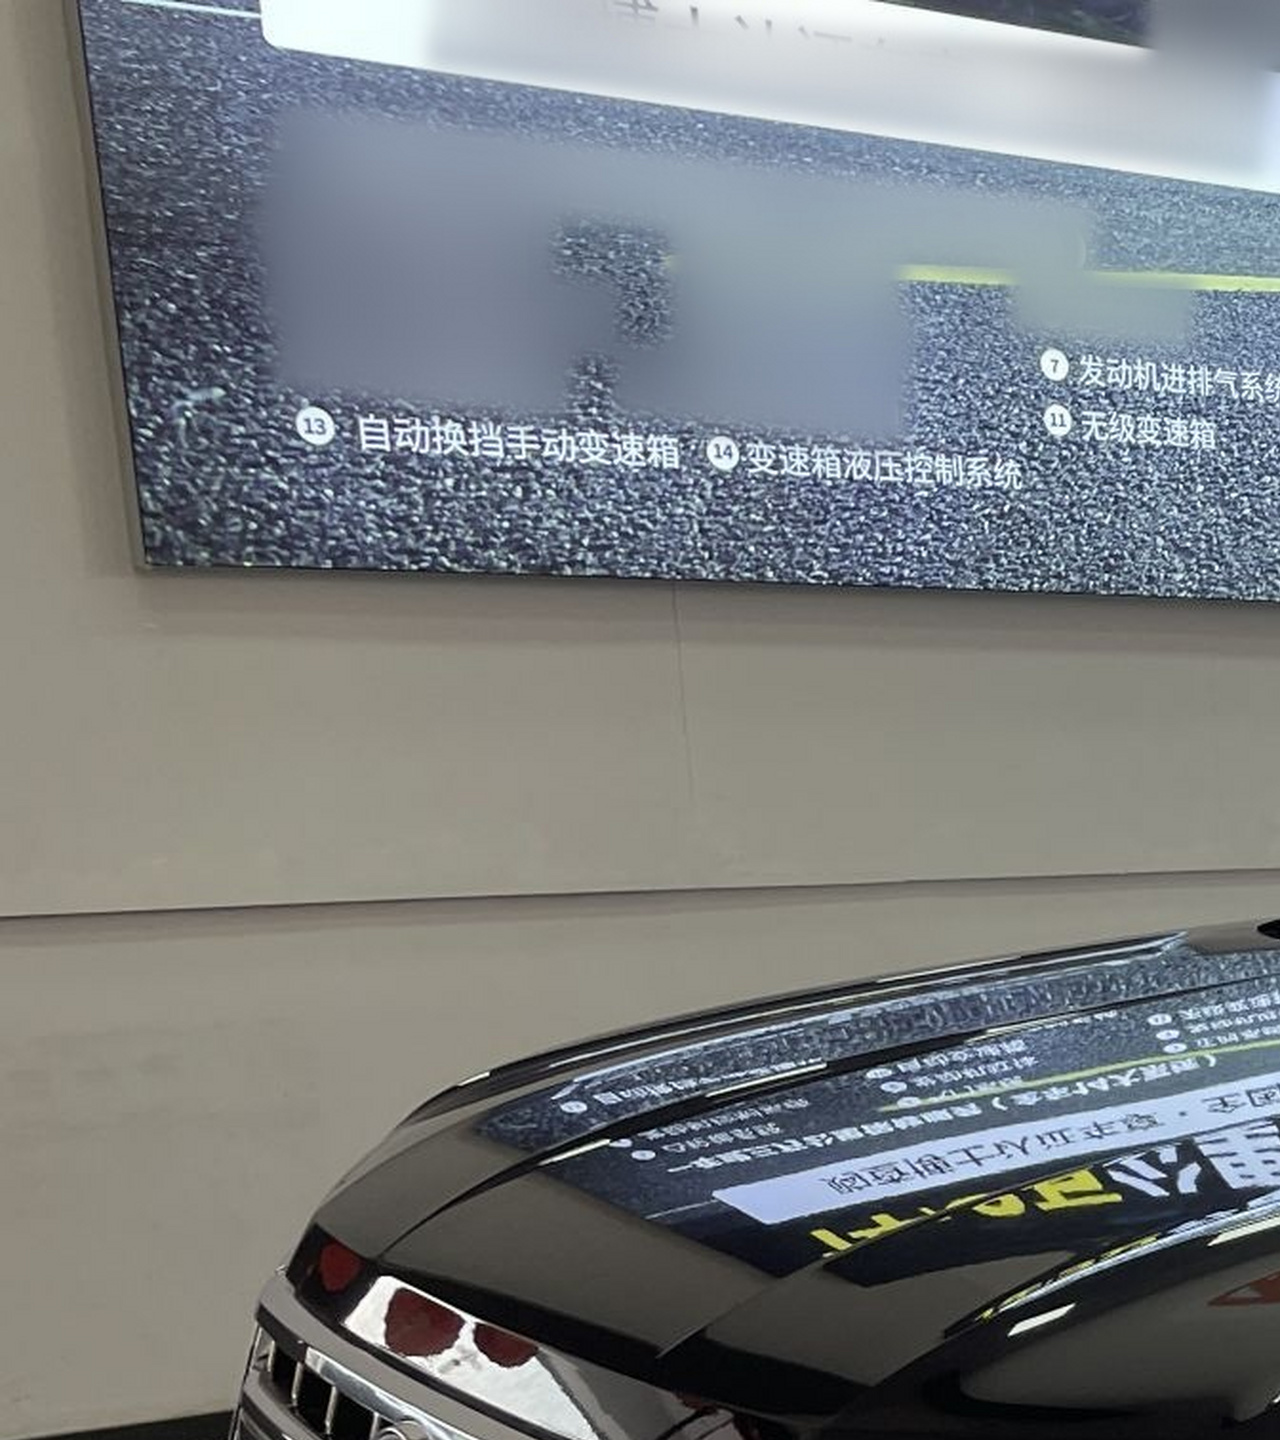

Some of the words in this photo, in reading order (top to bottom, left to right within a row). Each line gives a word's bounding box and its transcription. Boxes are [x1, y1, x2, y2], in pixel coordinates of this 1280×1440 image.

[357, 414, 681, 470] 自动换挡手动变速箱
[1081, 411, 1216, 450] 无级变速箱
[748, 443, 1024, 490] 变速箱液压控制系统
